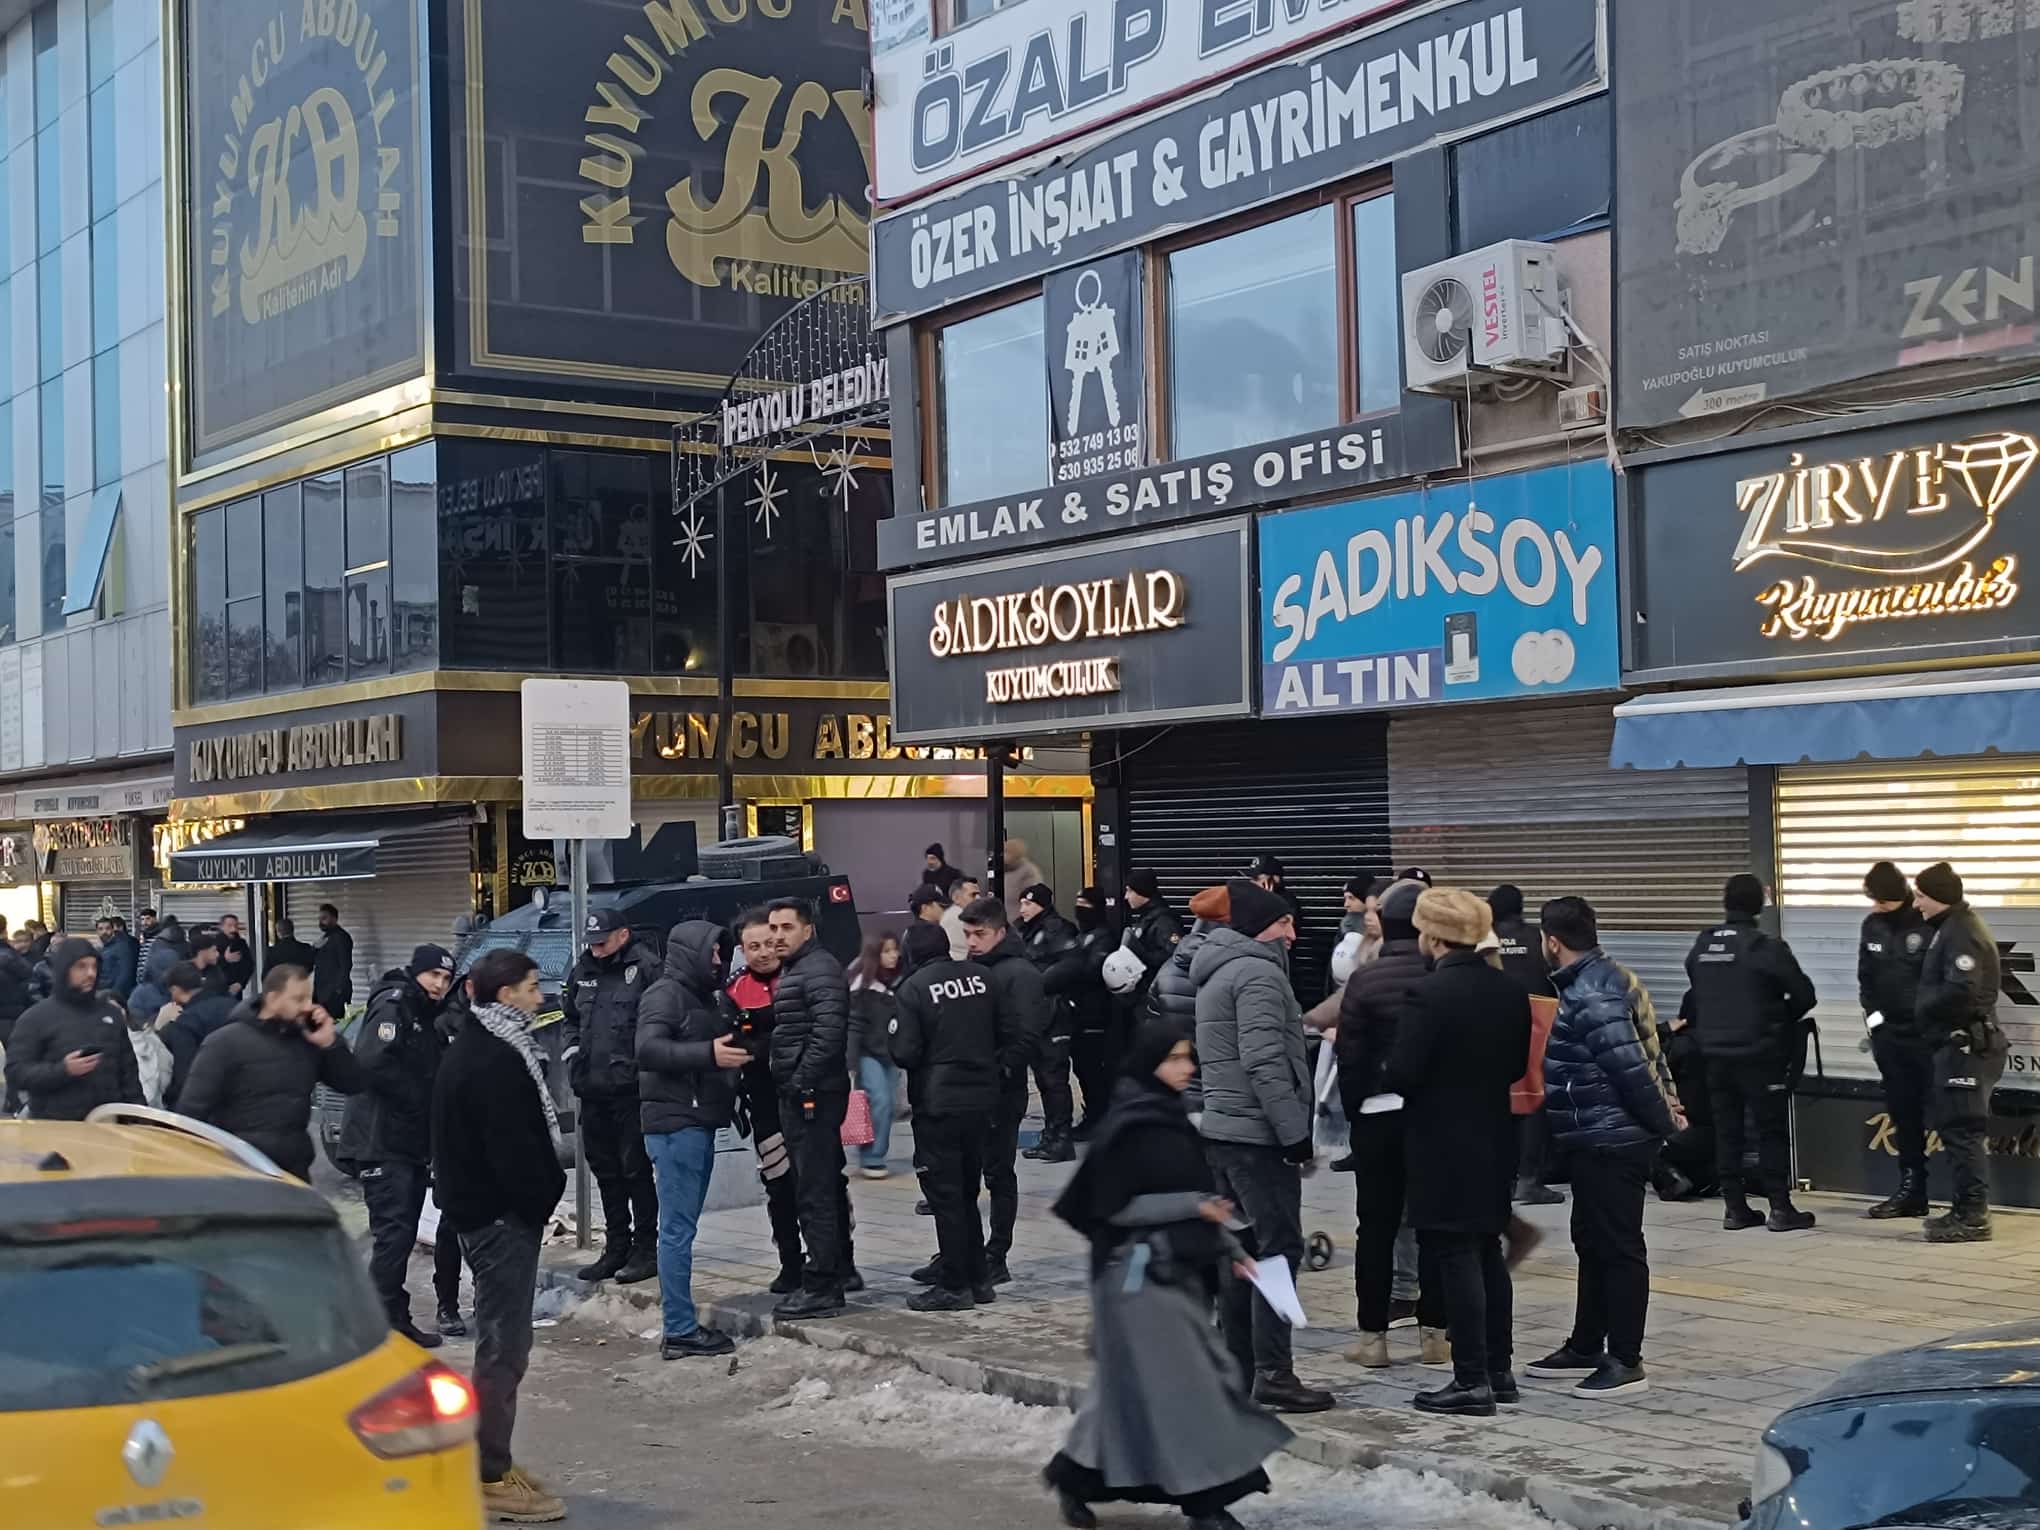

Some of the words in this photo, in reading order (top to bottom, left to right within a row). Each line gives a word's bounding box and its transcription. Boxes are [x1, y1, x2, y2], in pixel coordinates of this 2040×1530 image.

[578, 0, 792, 244] KUYUM
[911, 0, 1166, 174] ÖZALP
[210, 11, 286, 318] KUYUMCU
[300, 0, 401, 238] ABDULLAH
[911, 205, 999, 289] ÖZER
[1008, 150, 1139, 256] İNŞAAT
[1152, 137, 1188, 207] &
[1199, 7, 1539, 189] GAYRİMENKUL
[1482, 263, 1499, 347] VESTEL
[1901, 256, 2034, 338] ZEN
[1715, 330, 1769, 353] NOKTASI
[1717, 347, 1808, 377] KUYUMCULUK
[722, 386, 804, 446] İPEKYOLU
[1059, 437, 1081, 459] 532
[1082, 432, 1104, 453] 749
[1107, 427, 1121, 446] 13
[1058, 463, 1081, 481] 530
[1083, 456, 1105, 477] 935
[1107, 451, 1122, 470] 25
[917, 498, 1045, 550] EMLAK
[1061, 492, 1088, 523] &
[1106, 462, 1234, 505] SATIŞ
[928, 569, 1182, 659] SADIKSOYLAR
[1272, 510, 1602, 663] SADIKSOY
[985, 658, 1116, 703] KUYUMCULUK
[1275, 653, 1430, 710] ALTIN
[190, 729, 283, 783] KUYUMCU
[287, 714, 402, 772] ABDULLAH
[198, 857, 256, 880] KUYUMCU
[264, 853, 338, 878] ABDULLAH
